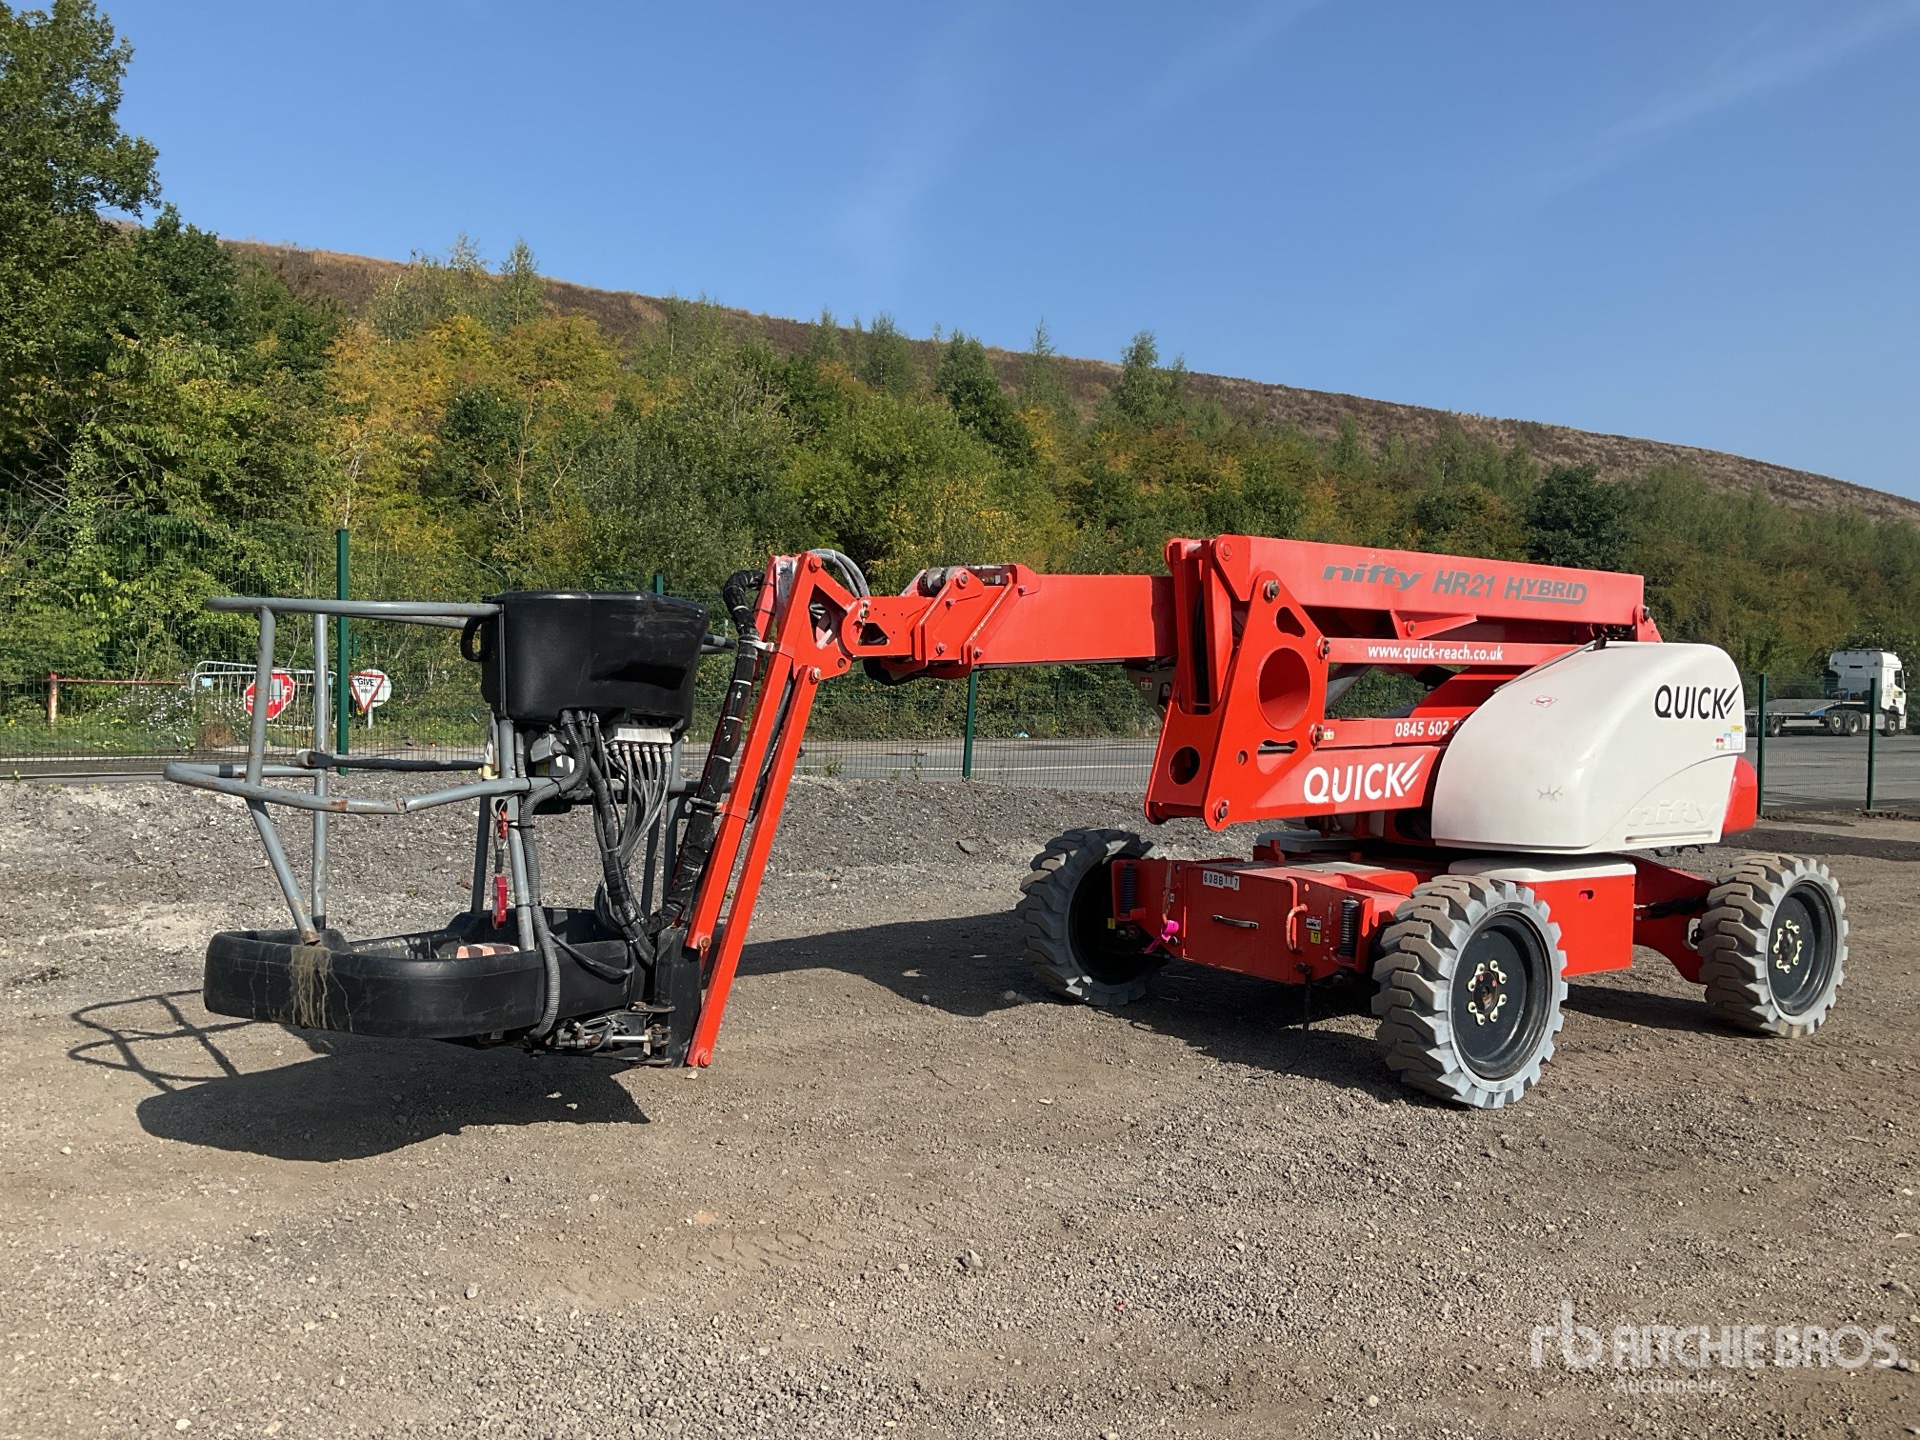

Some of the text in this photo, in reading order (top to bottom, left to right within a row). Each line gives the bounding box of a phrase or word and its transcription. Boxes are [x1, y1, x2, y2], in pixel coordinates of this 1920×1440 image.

[1322, 563, 1588, 606] nifty HR21 HYBRID
[1368, 643, 1504, 663] www.quick-reach.co.uk
[357, 677, 375, 687] GIVE
[1654, 684, 1728, 720] QUICK
[1395, 721, 1425, 738] 0845
[1428, 720, 1450, 736] 602
[1303, 761, 1407, 805] QUICK
[1627, 799, 1724, 829] nifty
